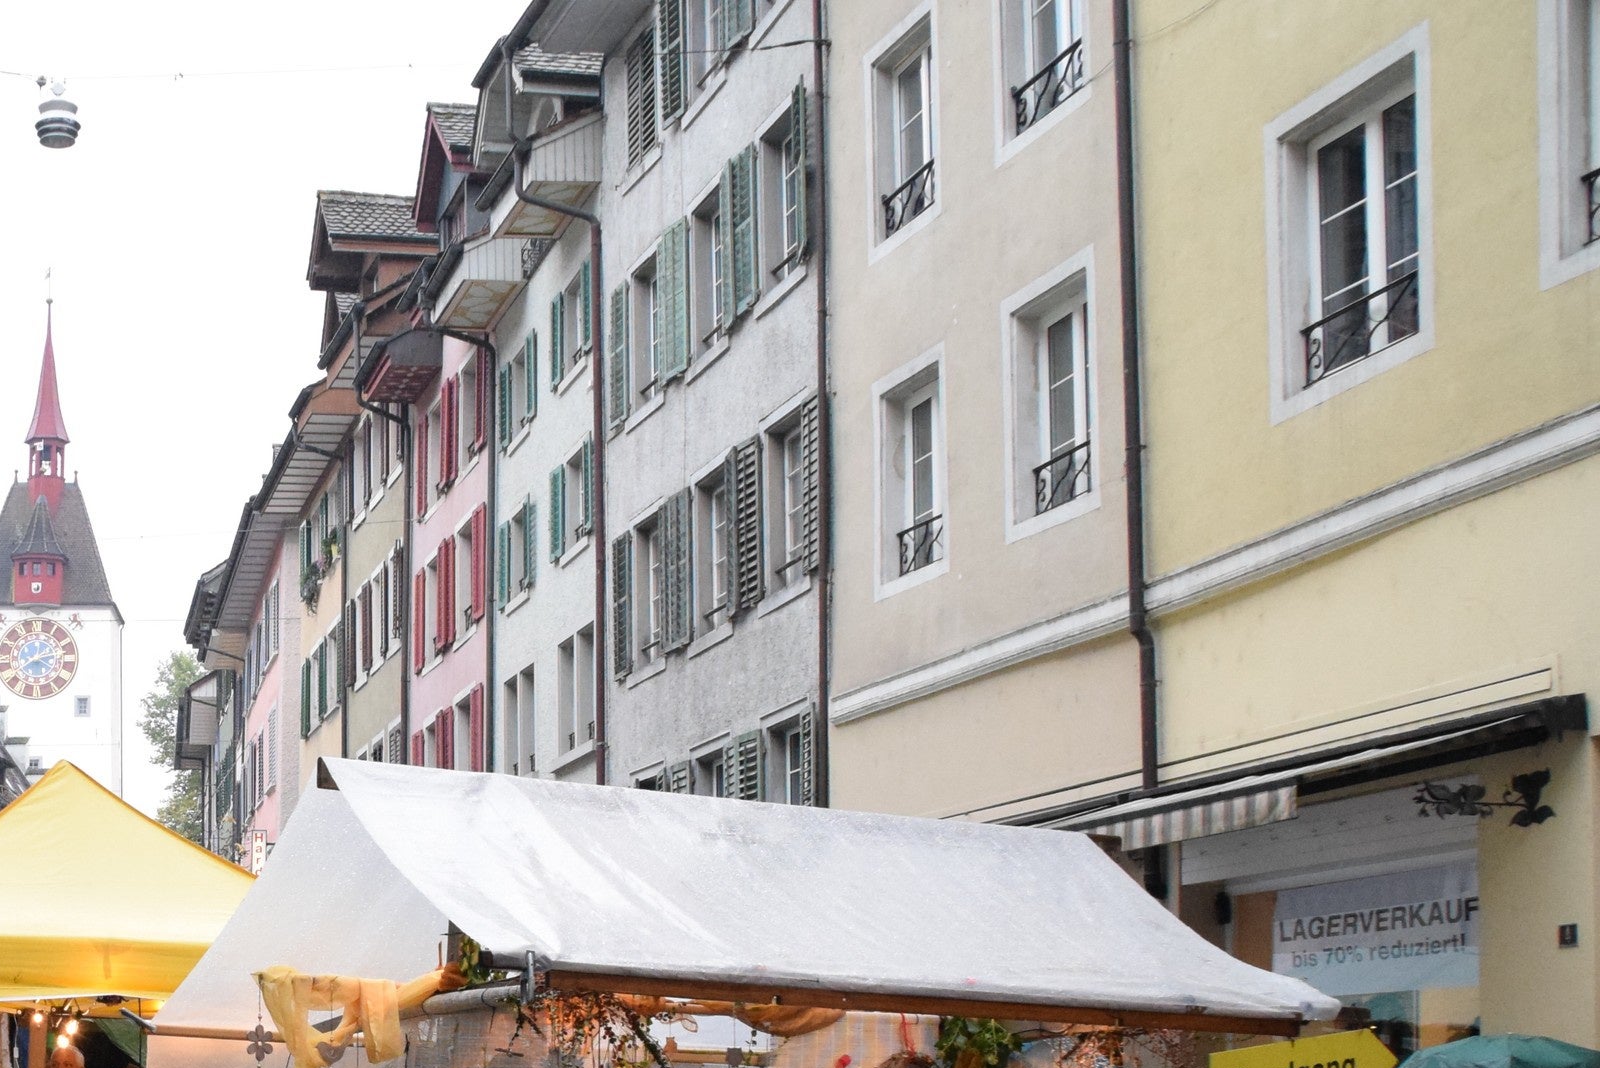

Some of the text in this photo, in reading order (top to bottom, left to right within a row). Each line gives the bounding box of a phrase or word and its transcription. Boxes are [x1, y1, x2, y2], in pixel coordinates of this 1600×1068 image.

[1279, 896, 1480, 943] LAGERVERKAUF
[1292, 933, 1467, 968] bis 70% reduziert!
